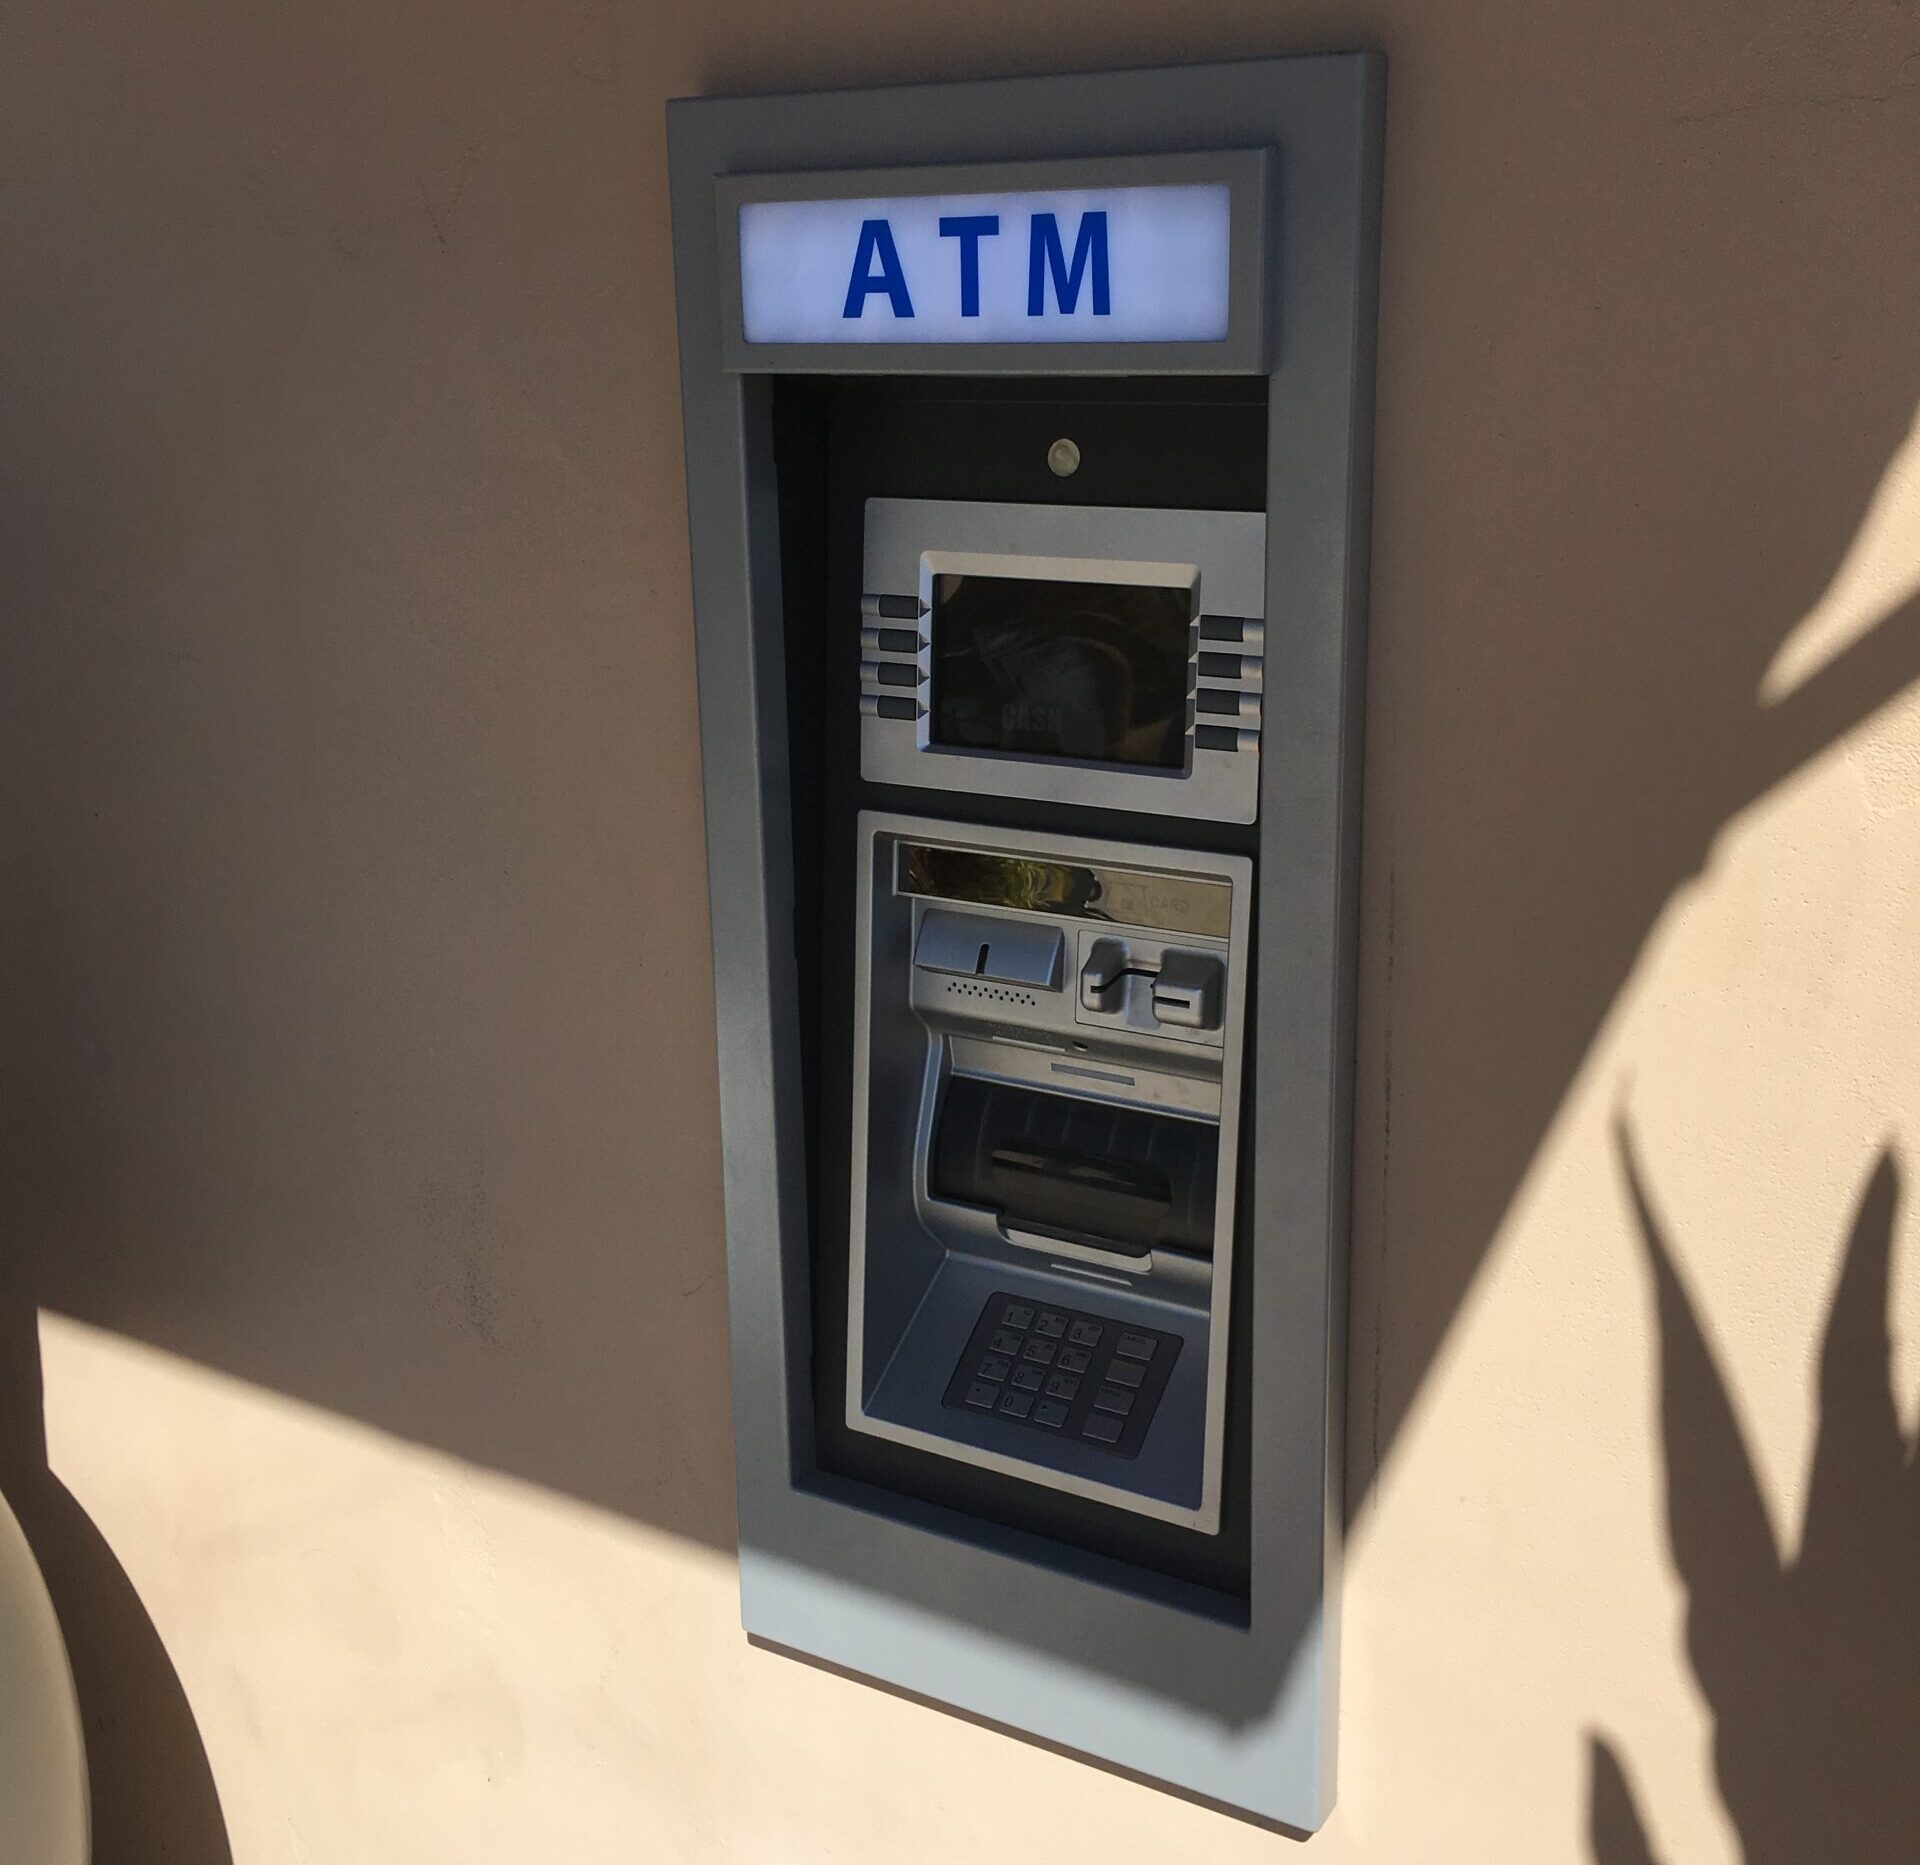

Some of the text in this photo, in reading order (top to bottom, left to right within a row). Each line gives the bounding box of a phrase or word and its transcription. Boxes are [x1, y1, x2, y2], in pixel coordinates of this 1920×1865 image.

[842, 211, 1111, 319] ATM
[1001, 703, 1063, 733] CASH
[1150, 895, 1191, 914] CARD
